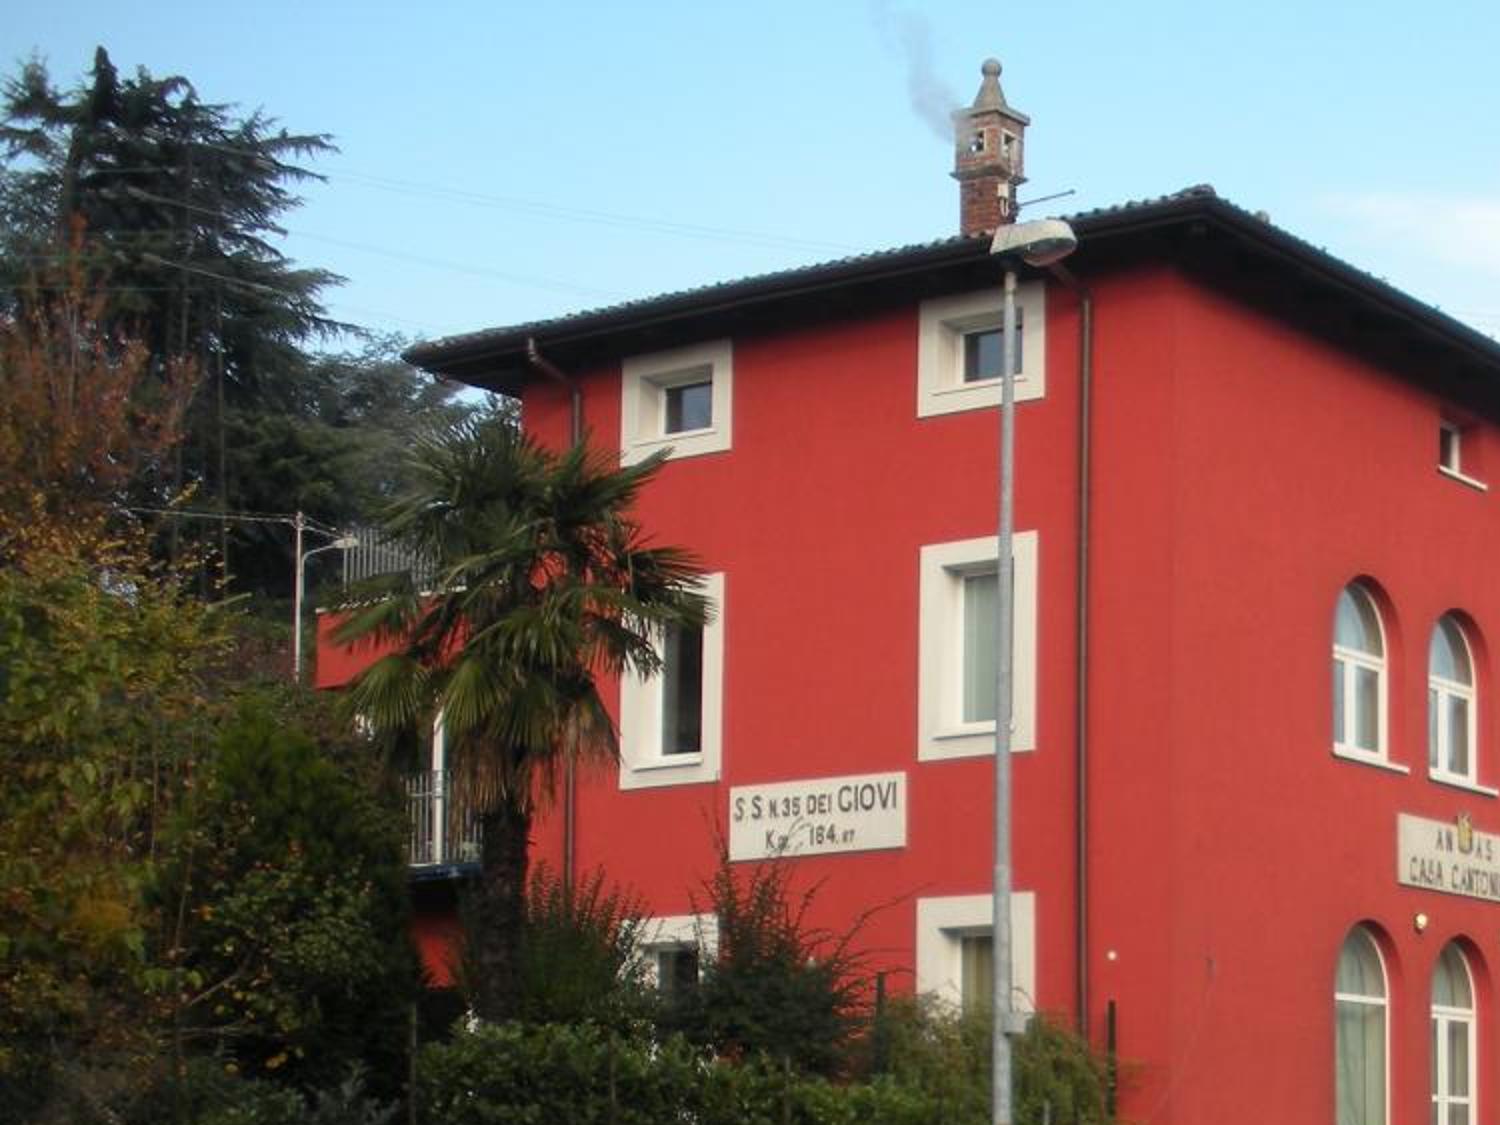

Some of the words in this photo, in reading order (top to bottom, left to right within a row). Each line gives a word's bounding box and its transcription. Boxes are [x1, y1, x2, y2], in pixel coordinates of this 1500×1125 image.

[807, 793, 832, 815] DEI
[837, 781, 898, 813] GIOVI
[1409, 856, 1443, 887] CASA
